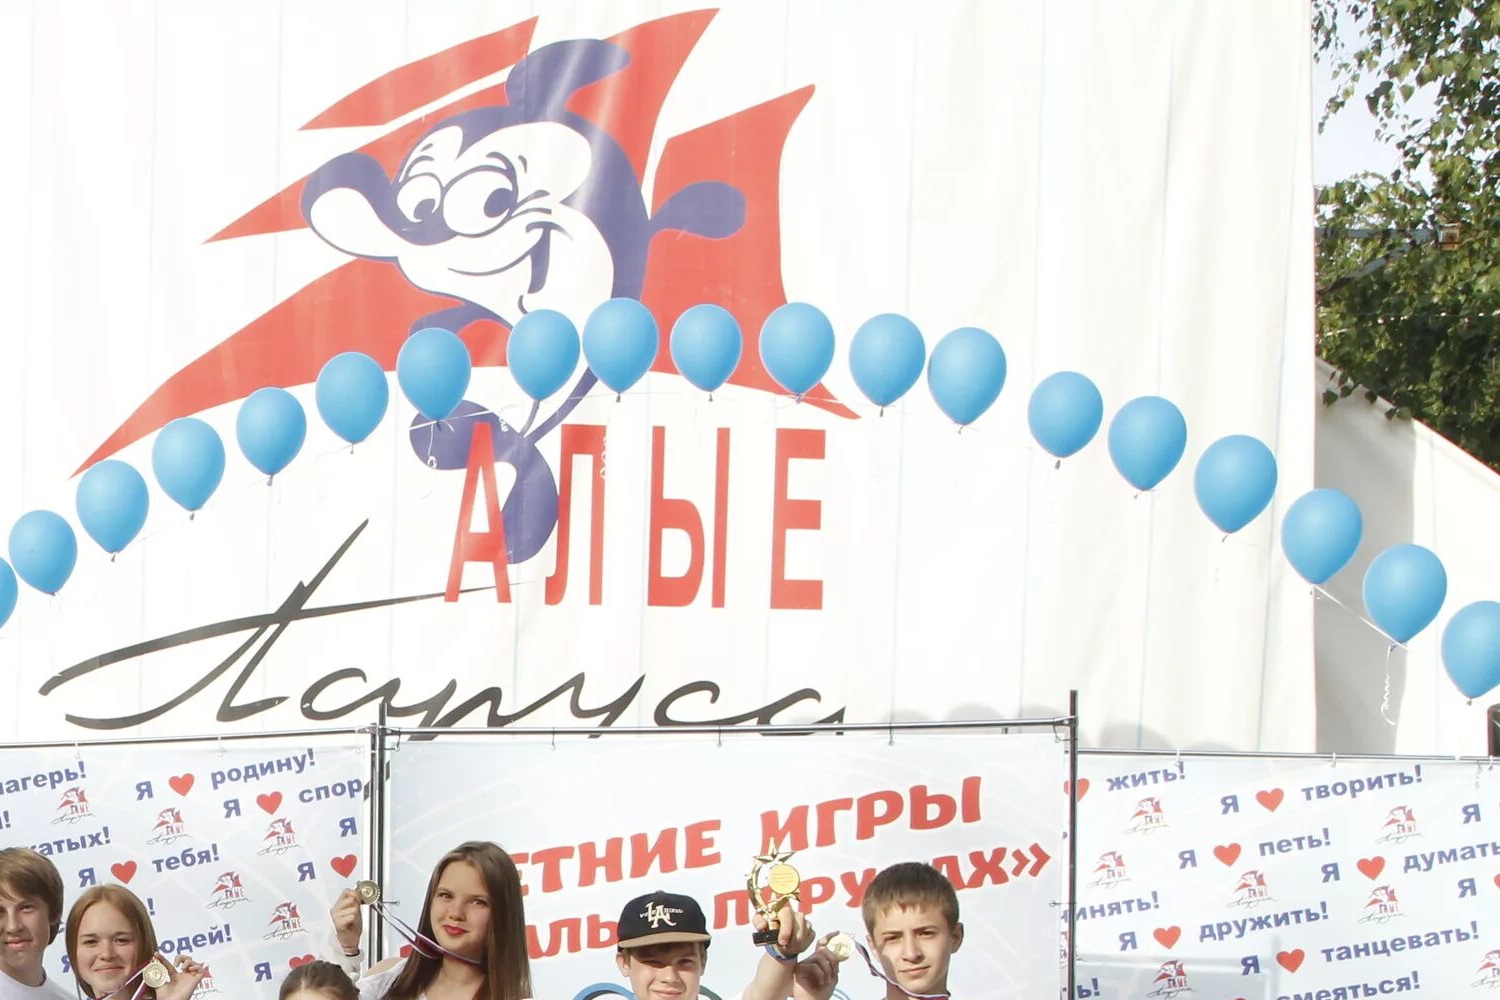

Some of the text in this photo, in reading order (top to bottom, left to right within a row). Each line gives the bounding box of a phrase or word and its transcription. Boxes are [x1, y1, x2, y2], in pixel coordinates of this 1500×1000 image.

[444, 422, 826, 609] АЛЫЕ
[136, 749, 316, 800] Я родину!
[1106, 762, 1186, 792] жить!
[1221, 765, 1423, 815] Я творить!
[223, 779, 364, 818] Я спор
[1461, 803, 1481, 824] Я
[339, 817, 357, 837] Я
[515, 775, 982, 896] ЕТНИЕ ИГРЫ
[78, 844, 220, 887] Я тебя!
[1178, 828, 1331, 869] Я петь!
[297, 862, 316, 881] Я
[1321, 863, 1340, 882] Я
[1457, 878, 1477, 897] Я
[160, 924, 232, 955] юдей!
[1119, 932, 1138, 951] Я
[1199, 902, 1329, 941] дружить!
[1241, 921, 1480, 975] Я танцевать!
[254, 961, 272, 982] Я
